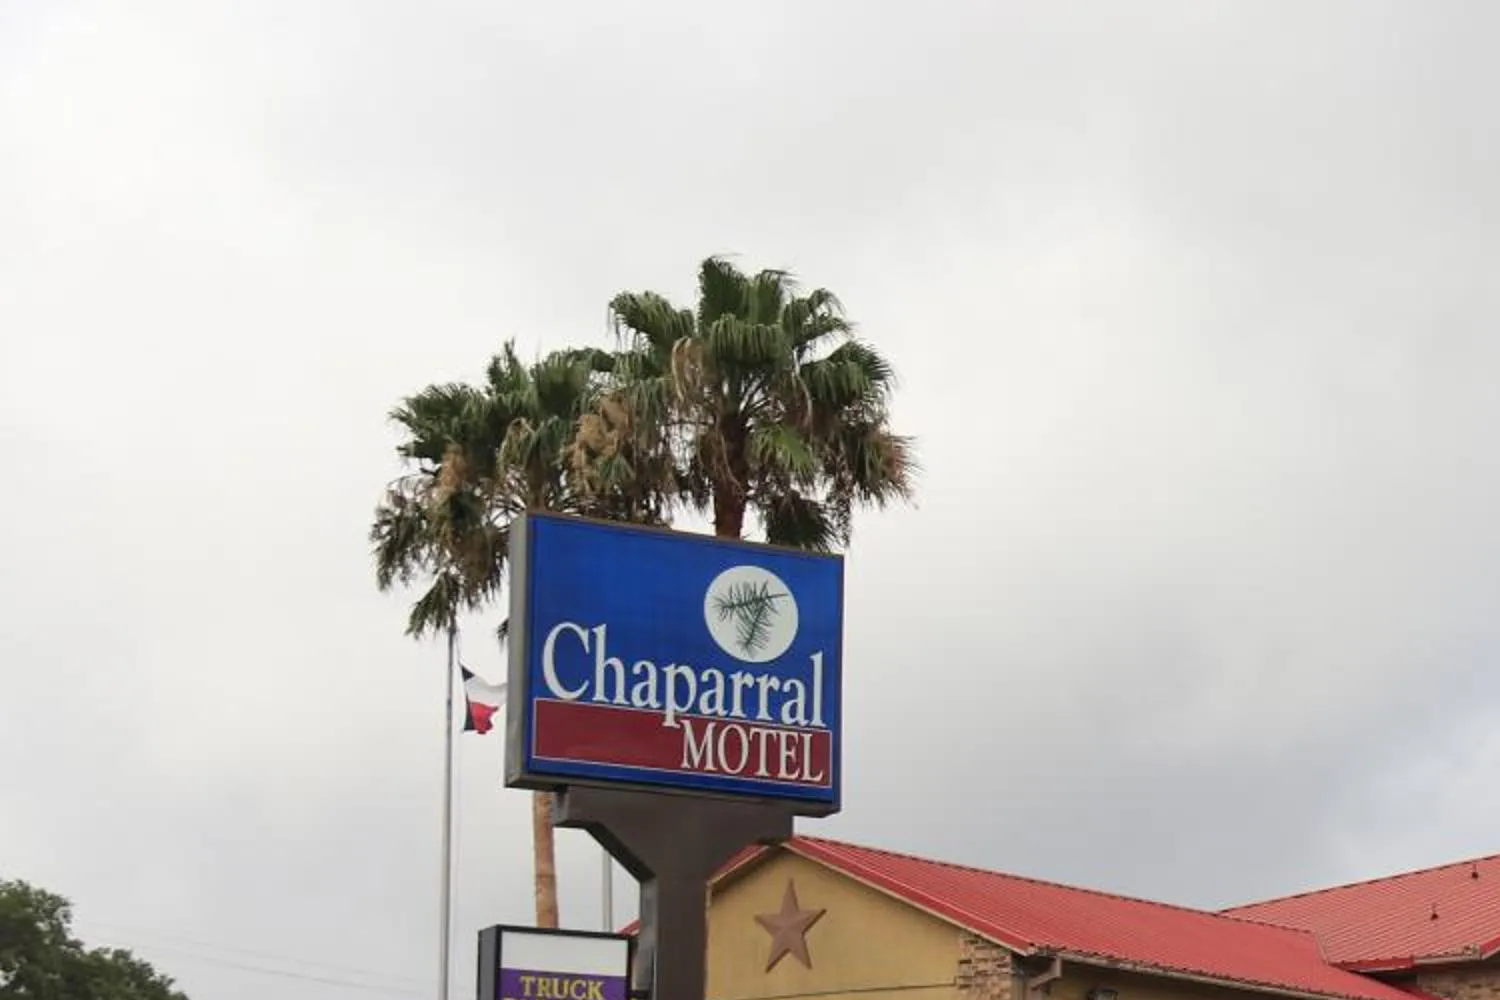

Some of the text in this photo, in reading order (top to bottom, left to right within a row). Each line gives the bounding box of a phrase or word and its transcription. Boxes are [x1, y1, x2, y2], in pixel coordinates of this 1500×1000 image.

[542, 621, 827, 729] Chaparral
[680, 719, 824, 782] MOTEL
[519, 975, 605, 1000] TRUCK
